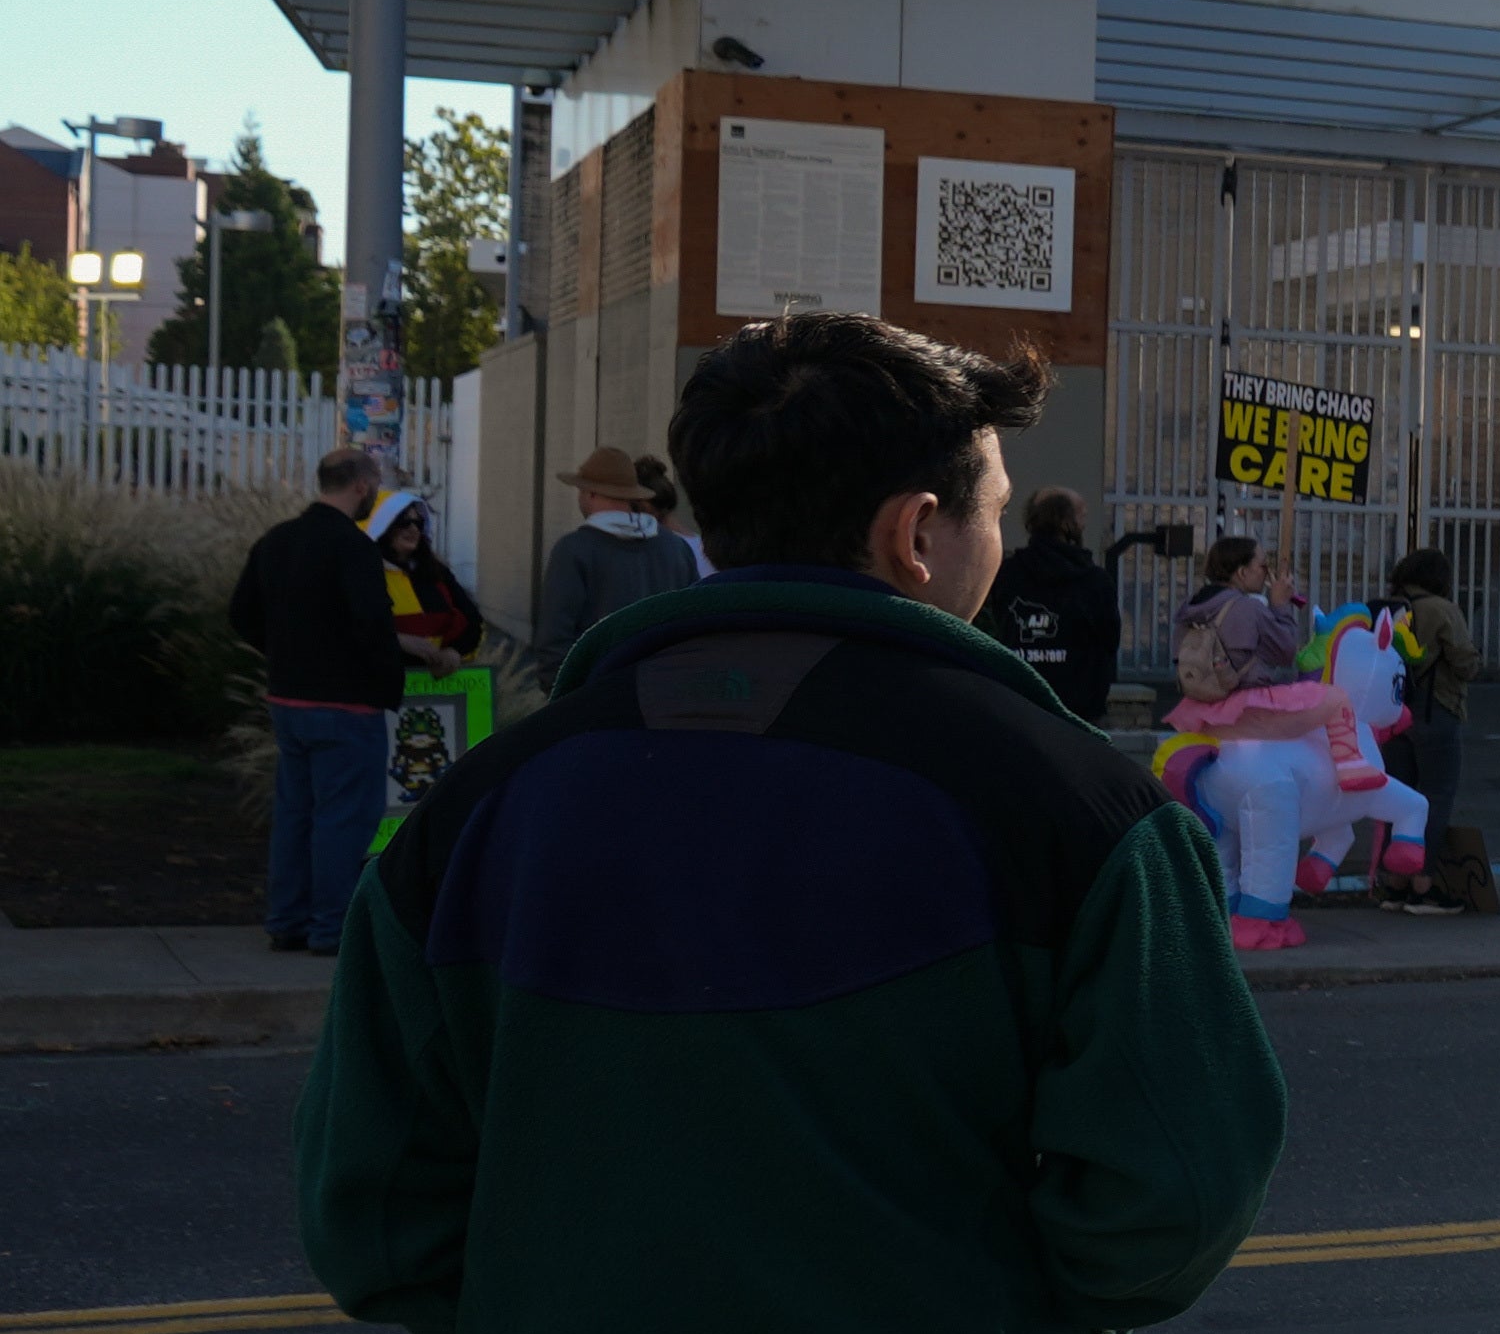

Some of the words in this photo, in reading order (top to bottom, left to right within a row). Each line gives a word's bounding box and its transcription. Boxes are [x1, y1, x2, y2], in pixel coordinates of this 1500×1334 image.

[1223, 372, 1264, 403] THEY
[1265, 380, 1315, 413] BRING
[1316, 389, 1373, 423] CHAOS
[1222, 400, 1272, 446] WE
[1274, 409, 1369, 464] BRING
[1229, 444, 1355, 502] CARE
